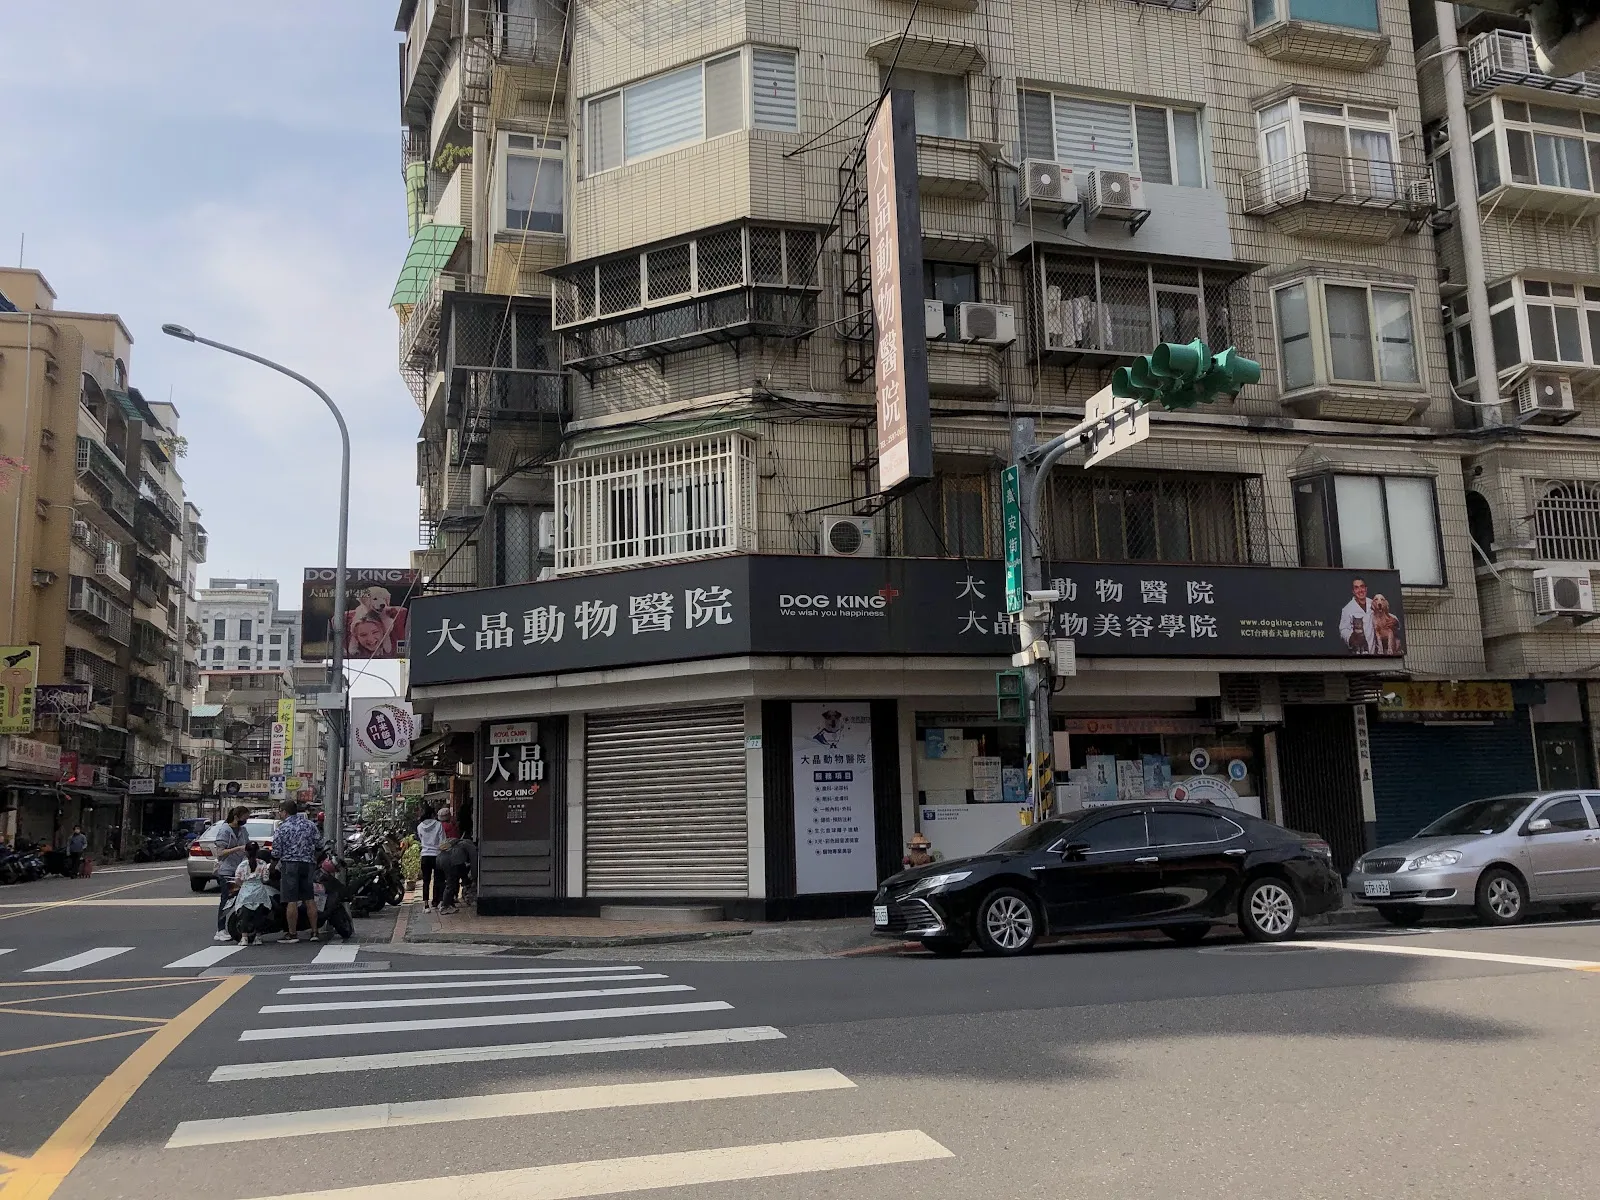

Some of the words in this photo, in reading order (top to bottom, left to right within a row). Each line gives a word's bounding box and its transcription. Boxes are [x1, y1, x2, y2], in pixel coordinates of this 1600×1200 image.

[872, 139, 901, 432] 大晶動物醫院
[358, 570, 402, 581] KING
[780, 594, 830, 608] DOG
[836, 595, 887, 609] KING
[780, 608, 796, 616] We
[798, 608, 819, 617] wish
[821, 609, 838, 618] you
[839, 609, 887, 618] happiness.
[426, 585, 734, 657] 大晶動物醫院
[1239, 619, 1324, 628] www.dogking.com.tw
[484, 744, 544, 783] 大晶
[801, 754, 867, 765] 大晶動物醫院
[493, 790, 513, 798] DOG
[515, 788, 535, 797] KING
